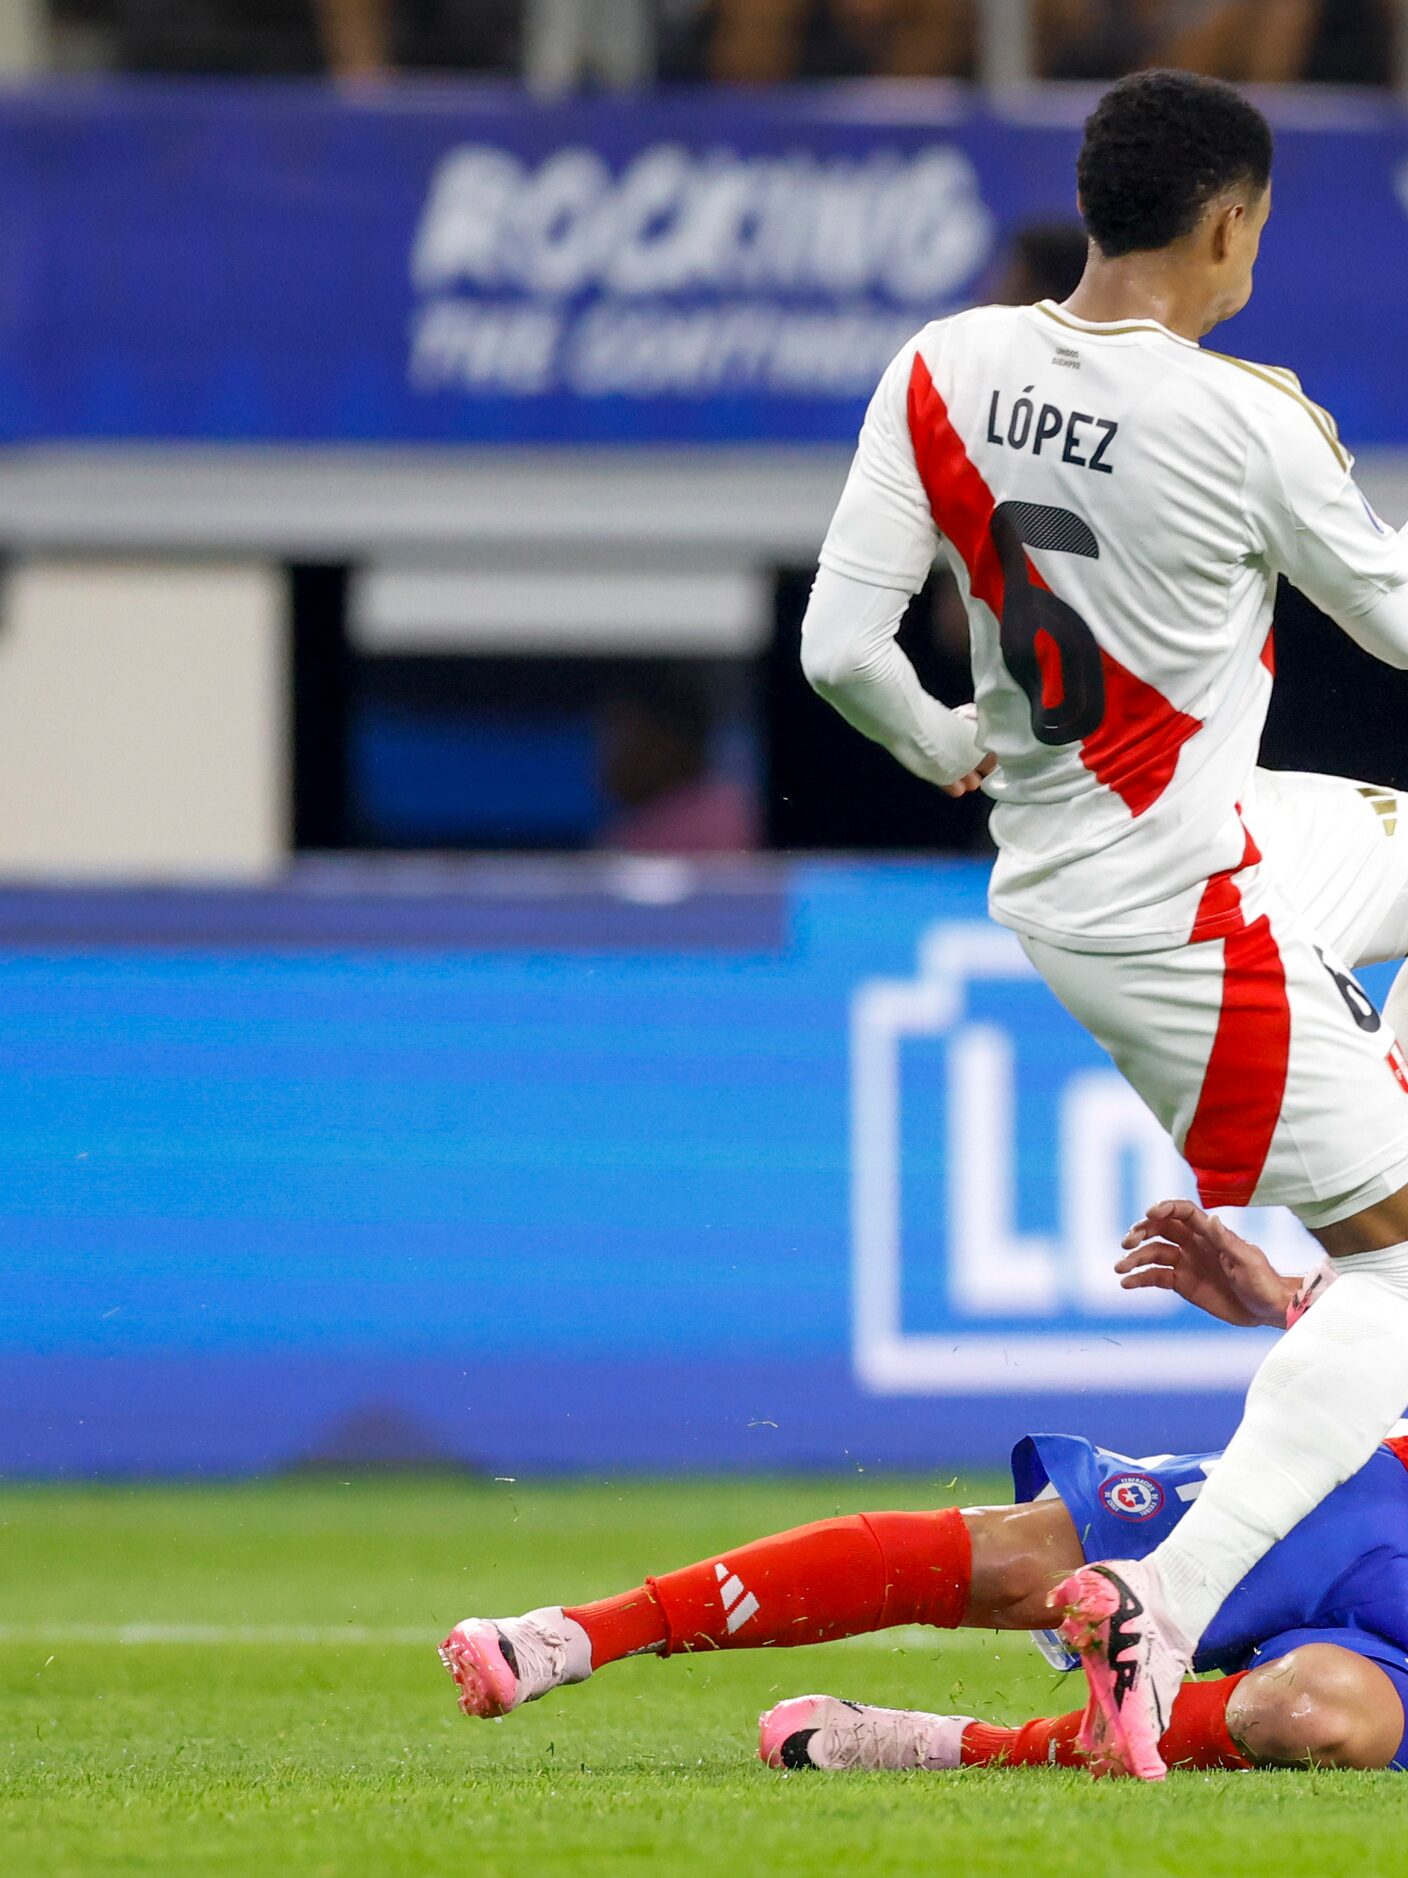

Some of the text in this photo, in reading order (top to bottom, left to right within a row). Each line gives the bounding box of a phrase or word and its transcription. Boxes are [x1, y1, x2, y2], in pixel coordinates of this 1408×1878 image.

[416, 149, 990, 297] ROCKING
[987, 384, 1119, 475] LÓPEZ
[989, 500, 1106, 746] 6
[1312, 944, 1381, 1033] 6
